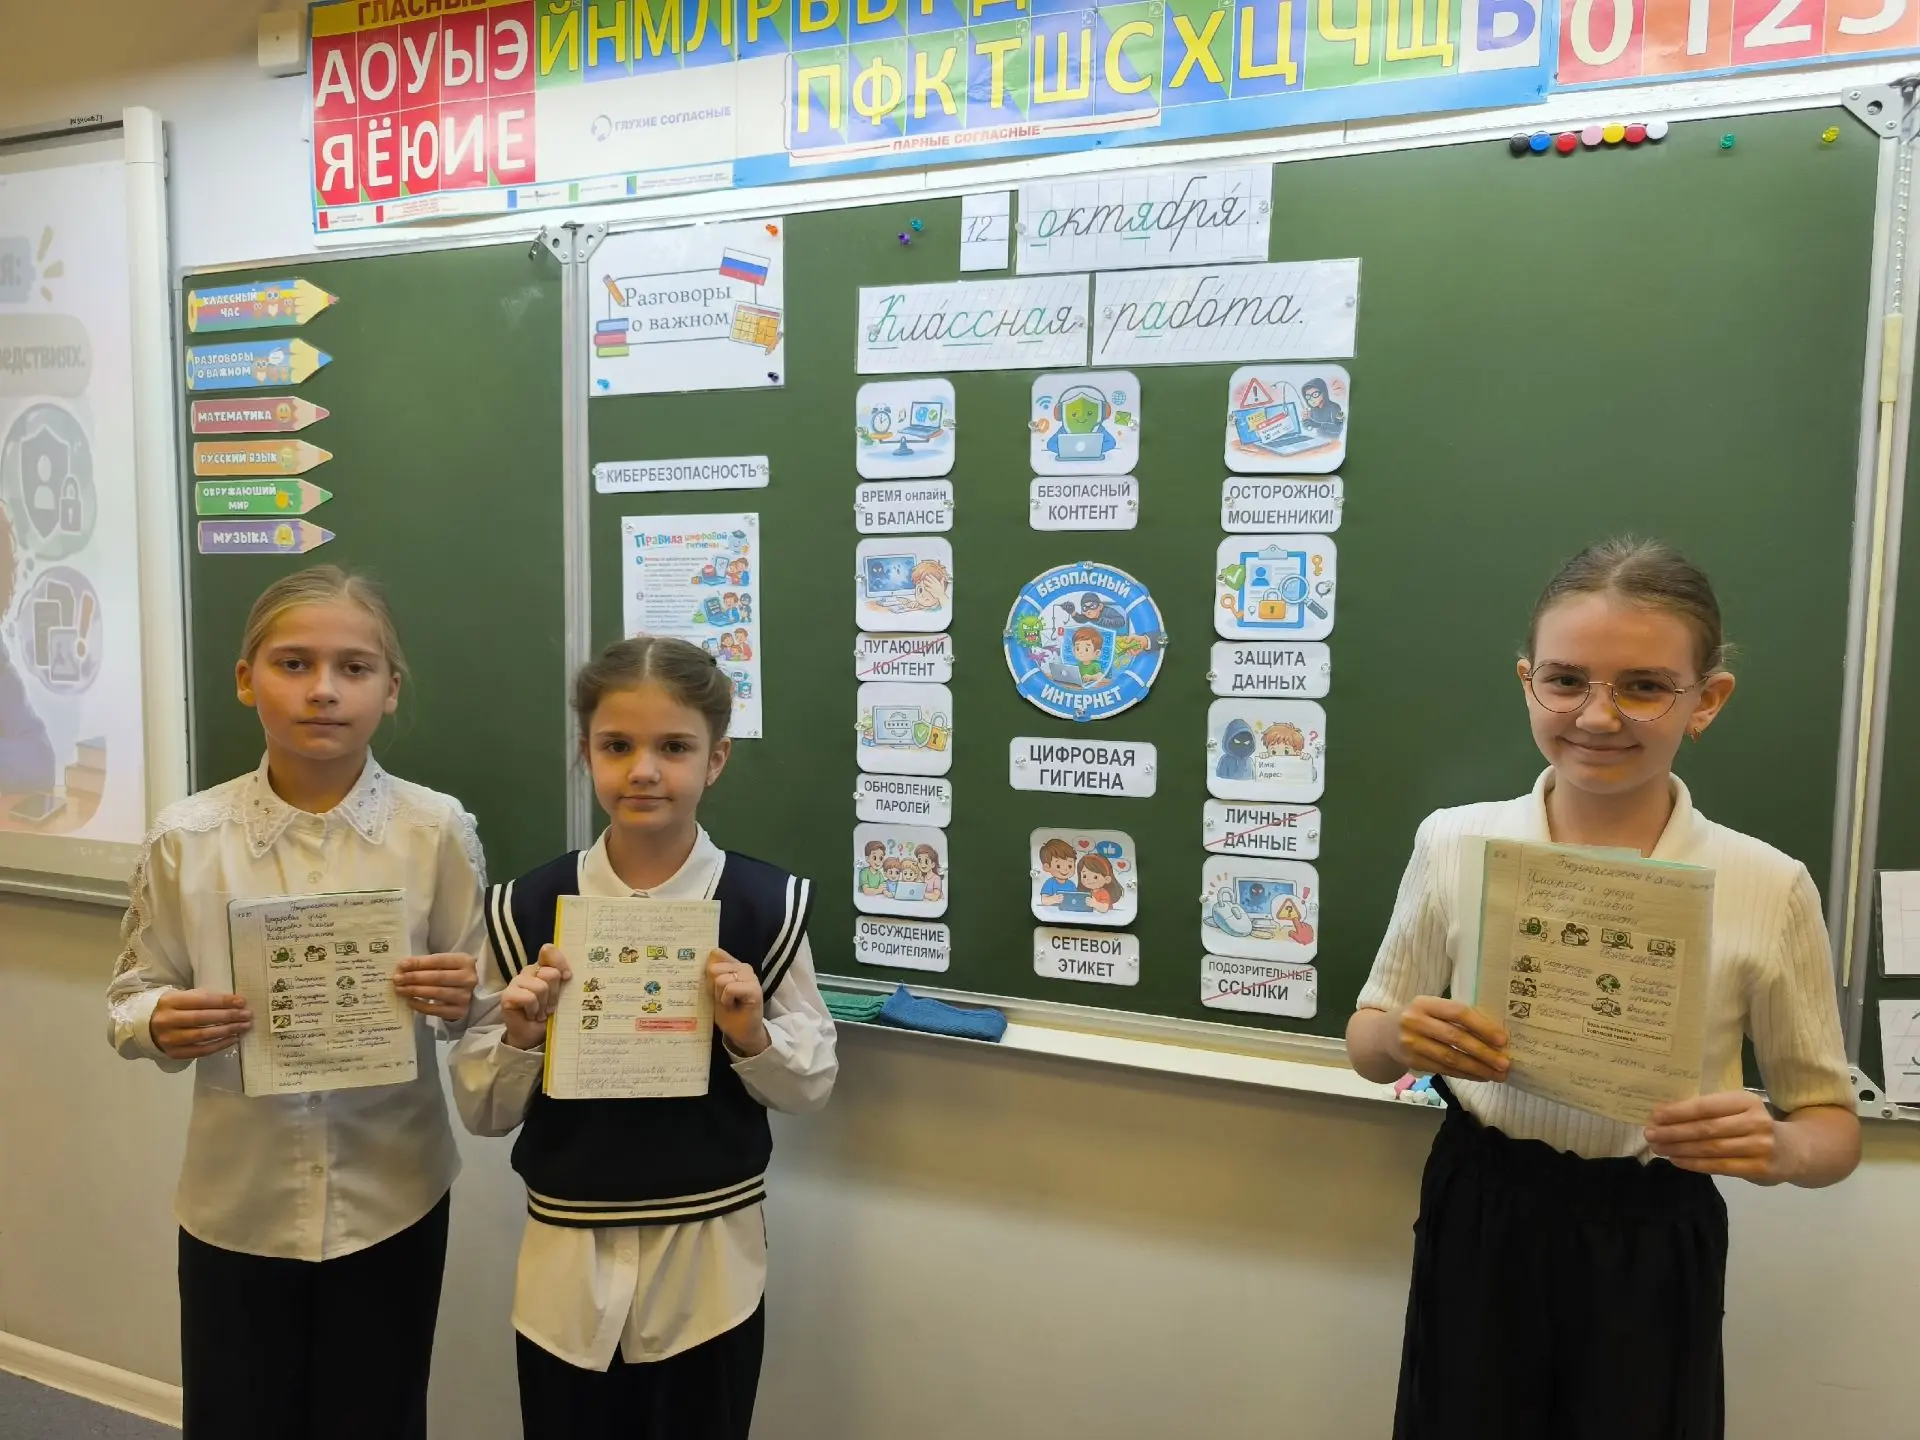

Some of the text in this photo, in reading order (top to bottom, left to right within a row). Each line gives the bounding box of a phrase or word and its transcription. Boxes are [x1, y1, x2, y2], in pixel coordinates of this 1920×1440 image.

[358, 0, 485, 26] ГЛАСН
[614, 106, 732, 132] ГЛУХИЕ СОГЛАСНЫЕ
[893, 125, 1041, 151] ПАРНЫЕ СОГЛАСНЫЕ
[965, 215, 989, 242] 12
[203, 288, 258, 305] КЛАССНЫЙ
[624, 285, 732, 308] Разговоры
[220, 307, 240, 318] ЧАС
[868, 294, 1073, 343] Классная
[631, 319, 643, 333] о
[192, 352, 254, 366] РАЗГОВОРЫ
[207, 366, 251, 378] ВАЖНОМ
[198, 410, 273, 422] МАТЕМАТИКА
[200, 450, 277, 463] РУССКИЙ ЯЗЫК
[606, 463, 757, 484] КИБЕРБЕЗОПАСНОСТЬ
[203, 483, 277, 497] ОКРУЖАЮЩИЙ
[862, 489, 947, 503] ВРЕМЯ онлайн
[1037, 480, 1131, 498] БЕЗОПАСНЫЙ
[1229, 484, 1334, 500] ОСТОРОЖНО!
[228, 501, 249, 510] МИР
[1048, 504, 1119, 521] КОНТЕНТ
[864, 510, 945, 526] В БАЛАНСЕ
[1228, 509, 1333, 524] МОШЕННИКИ!
[213, 532, 269, 544] МУЗЫКА
[634, 533, 683, 548] Правила
[1036, 571, 1132, 598] БЕЗОПАСНЫЙ
[864, 640, 945, 657] ПУГАЮЩИЙ
[1234, 650, 1306, 669] ЗАЩИТА
[872, 661, 935, 677] КОНТЕНТ
[1232, 674, 1307, 692] ДАННЫХ
[1040, 684, 1123, 709] ИНТЕРНЕТ
[1029, 744, 1135, 767] ЦИФРОВАЯ
[864, 780, 944, 797] ОБНОВЛЕНИЕ
[1039, 769, 1124, 790] ГИГИЕНА
[875, 798, 930, 815] ПАРОЛЕЙ
[1224, 808, 1298, 828] ЛИЧНЫЕ
[1223, 832, 1297, 851] ДАННЫЕ
[861, 922, 945, 943] ОБСУЖДЕНИЕ
[871, 942, 944, 960] РОДИТЕЛЯМИ
[1051, 935, 1122, 956] СЕТЕВОЙ
[1057, 958, 1115, 978] ЭТИКЕТ
[1208, 961, 1313, 982] ПОДОЗРИТЕЛЬНЫЕ
[1217, 979, 1289, 1001] ССЫЛКИ
